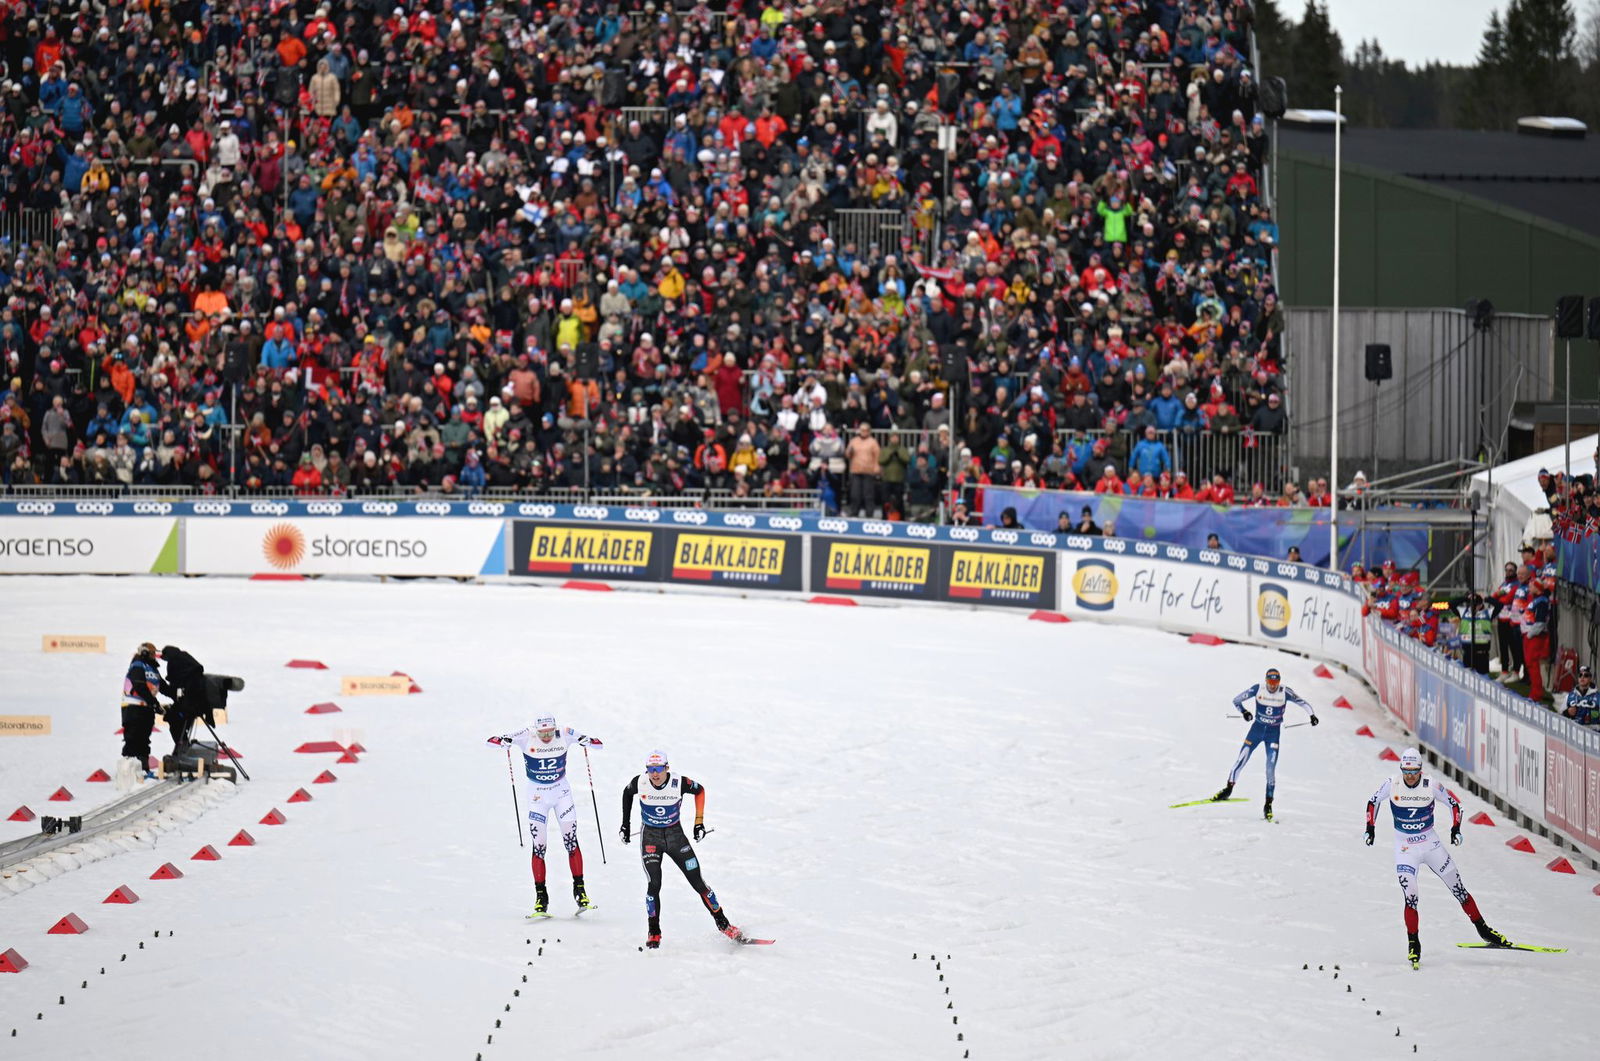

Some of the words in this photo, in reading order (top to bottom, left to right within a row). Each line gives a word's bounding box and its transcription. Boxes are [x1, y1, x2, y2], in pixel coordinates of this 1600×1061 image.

[16, 502, 55, 515] coop
[75, 502, 114, 515] coop
[133, 502, 172, 515] coop
[193, 502, 231, 515] coop
[251, 502, 289, 515] coop
[307, 502, 343, 515] coop
[362, 502, 398, 515] coop
[415, 502, 451, 515] coop
[468, 502, 504, 515] coop
[519, 503, 555, 517] coop
[573, 505, 608, 519] coop
[625, 508, 660, 523] coop
[673, 510, 707, 525] coop
[723, 513, 756, 528] coop
[768, 516, 802, 531] coop
[818, 519, 848, 533] coop
[862, 521, 893, 536] coop
[906, 524, 936, 539] coop
[950, 527, 979, 541] coop
[991, 530, 1018, 544] coop
[1031, 533, 1057, 547] coop
[1067, 536, 1092, 549] coop
[1103, 538, 1126, 553] coop
[1135, 542, 1157, 556] coop
[1166, 546, 1188, 561] coop
[1199, 551, 1221, 565] coop
[1227, 554, 1247, 569] coop
[536, 530, 646, 562] BLÅKLÄDER
[680, 537, 779, 570] BLÅKLÄDER
[833, 546, 924, 579] BLÅKLÄDER
[955, 554, 1039, 588] BLÅKLÄDER
[1129, 569, 1155, 603] Fit
[1160, 572, 1184, 616] for
[1190, 577, 1224, 622] Life
[1300, 596, 1318, 632] Fit
[1265, 706, 1273, 715] 8
[536, 773, 560, 781] coop
[538, 758, 558, 770] 12
[655, 806, 666, 816] 9
[1402, 822, 1425, 830] coop
[1407, 808, 1418, 818] 7
